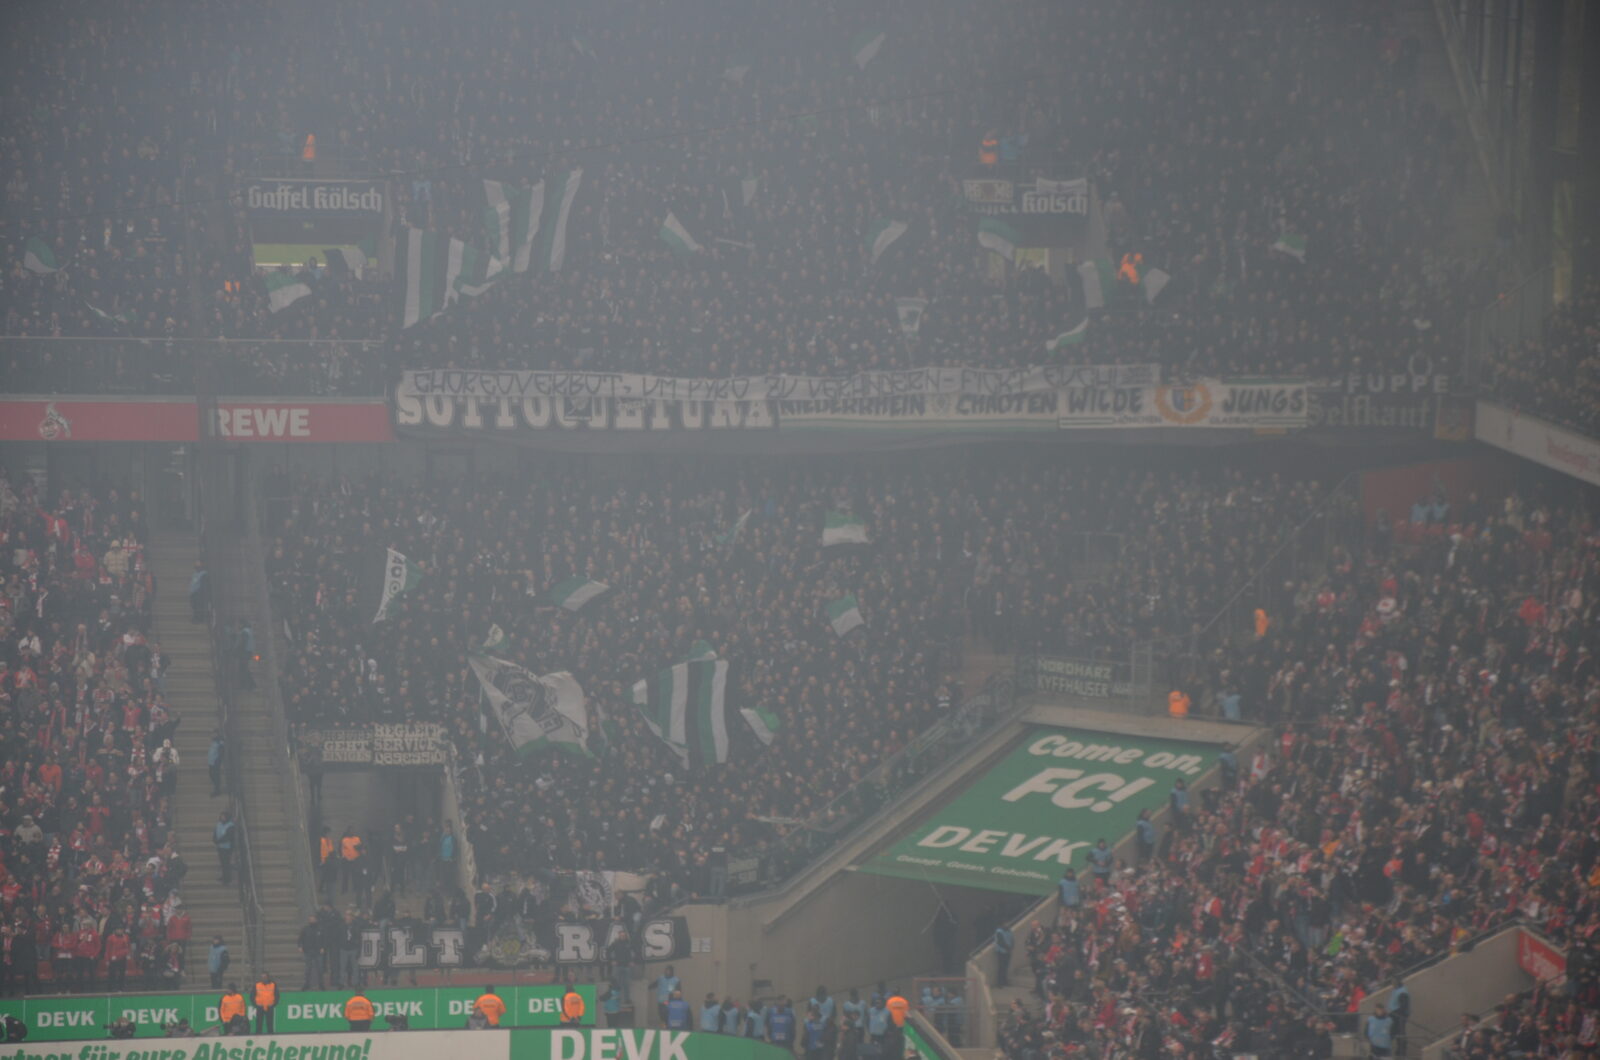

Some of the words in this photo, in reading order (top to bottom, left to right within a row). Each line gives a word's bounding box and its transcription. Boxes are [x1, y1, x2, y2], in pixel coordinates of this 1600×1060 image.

[248, 185, 310, 211] Gaffel
[313, 186, 383, 213] Kölsch
[1067, 387, 1143, 413] WILDE
[1223, 387, 1307, 413] JUNGS
[207, 407, 312, 437] REWE
[1027, 734, 1145, 765] Come
[1142, 750, 1203, 776] on,
[1001, 766, 1157, 814] FC!
[915, 824, 1092, 865] DEVK
[37, 1010, 96, 1028] DEVK
[122, 1008, 179, 1025] DEVK
[287, 1003, 343, 1020] DEVK
[550, 1028, 692, 1060] DEVK
